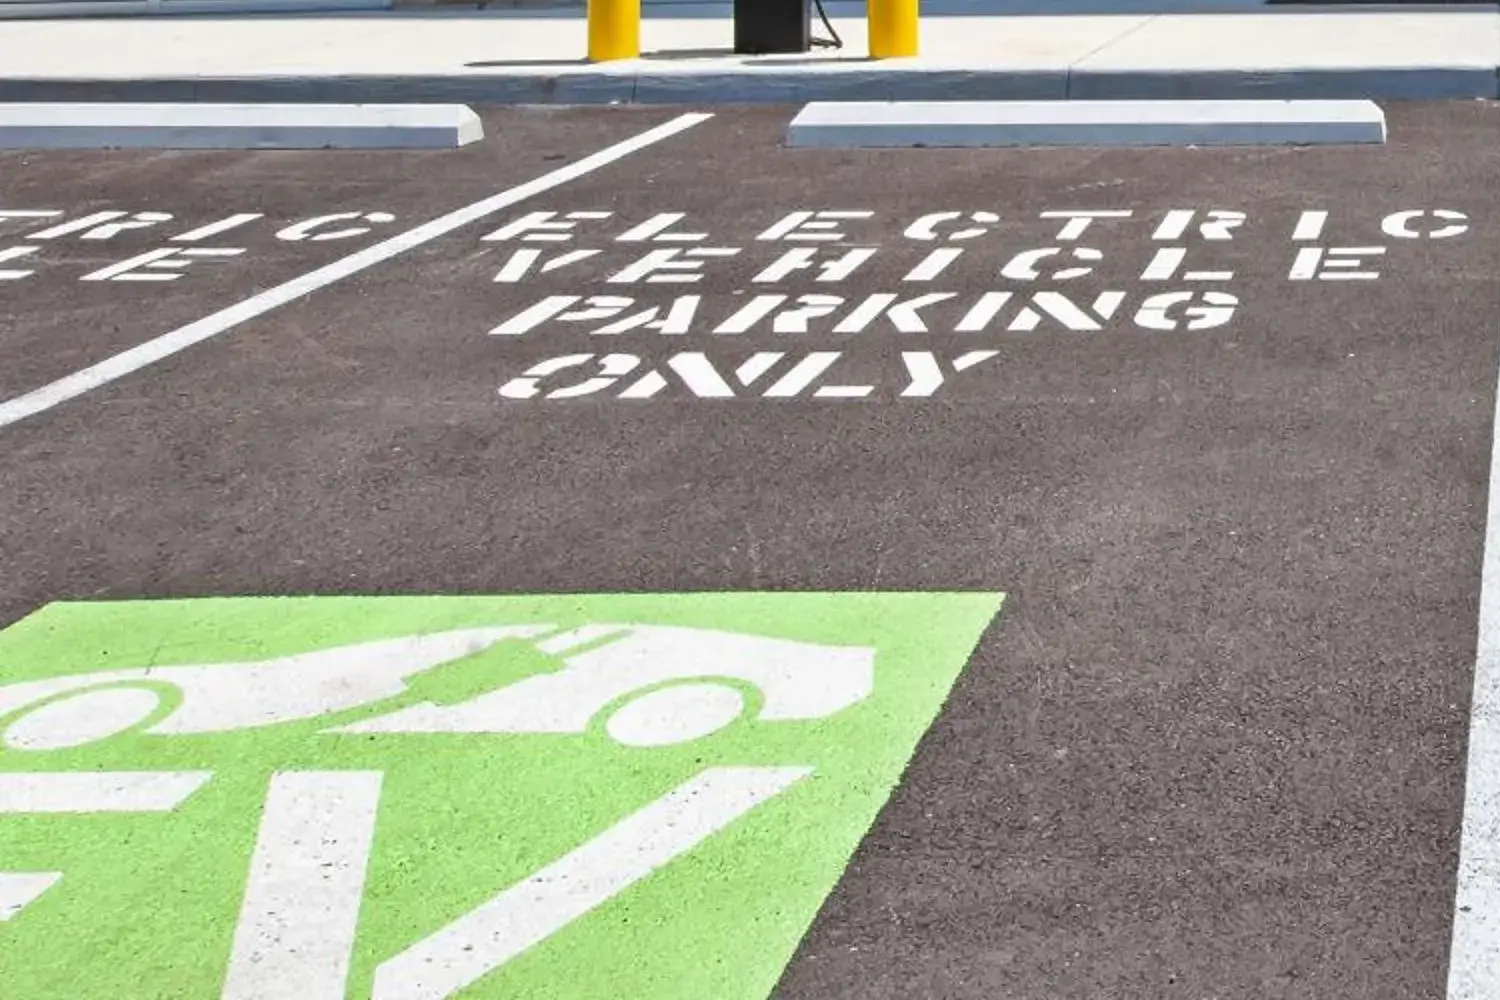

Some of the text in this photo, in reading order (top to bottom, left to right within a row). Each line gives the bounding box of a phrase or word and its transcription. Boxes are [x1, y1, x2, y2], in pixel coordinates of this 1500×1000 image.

[480, 209, 1469, 241] ELECTRIC
[493, 246, 1387, 282] VEHICLE
[488, 290, 1239, 335] PARKING
[498, 350, 1000, 399] ONLY
